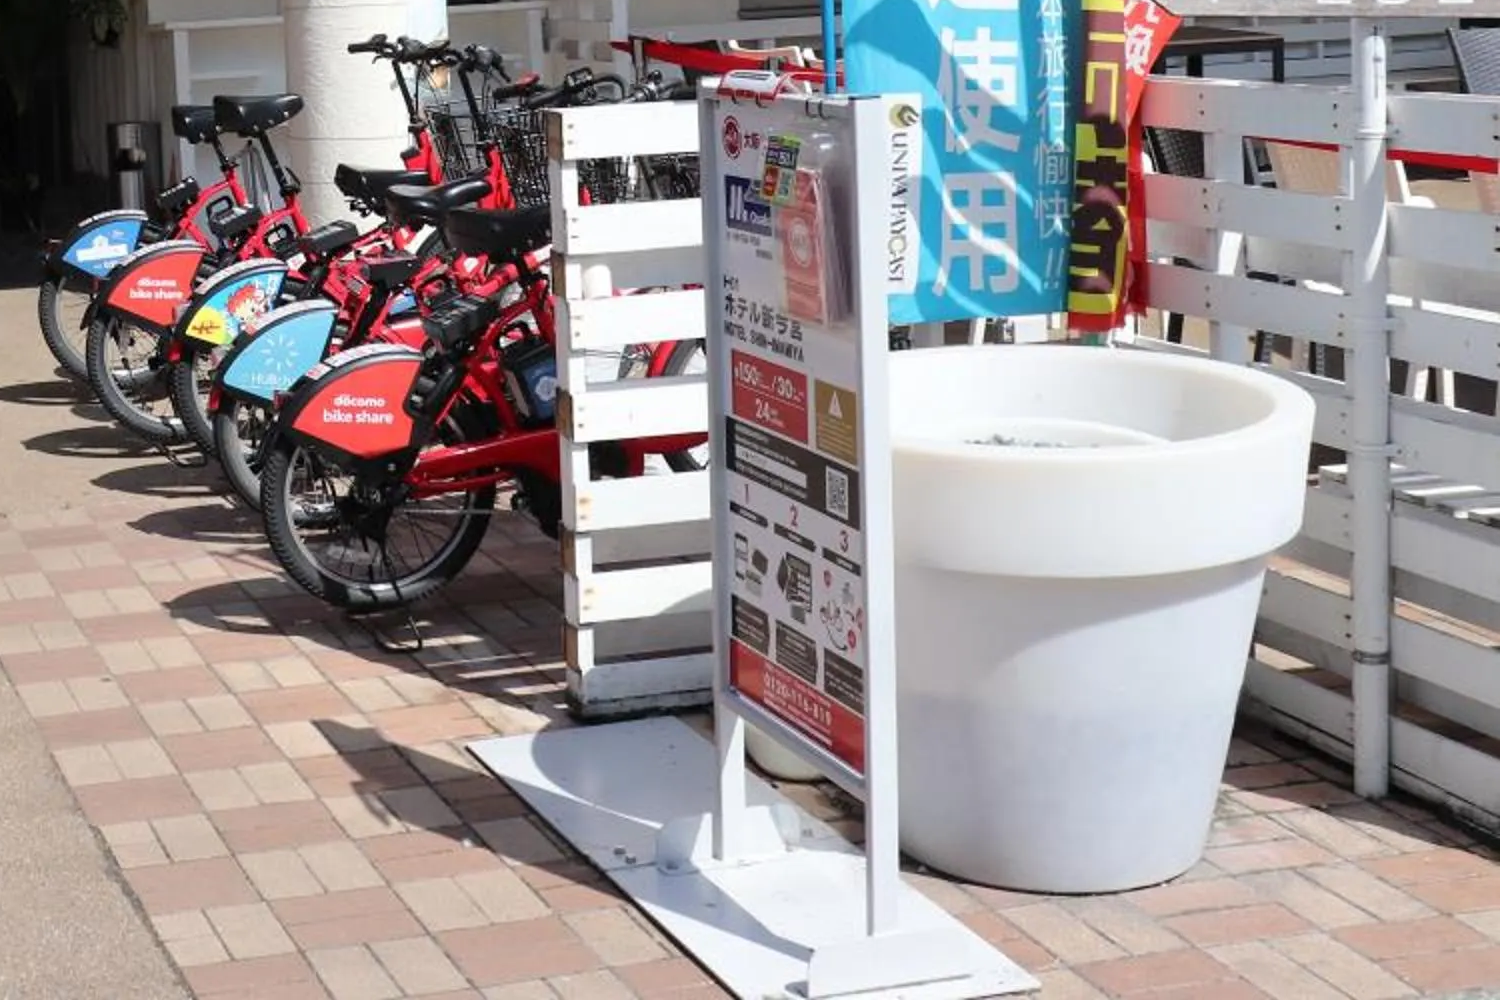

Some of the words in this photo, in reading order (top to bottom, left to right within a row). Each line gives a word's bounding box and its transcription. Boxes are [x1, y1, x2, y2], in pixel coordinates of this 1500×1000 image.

[129, 289, 152, 300] bike
[153, 289, 184, 301] share
[323, 408, 352, 424] bike
[355, 409, 394, 425] share
